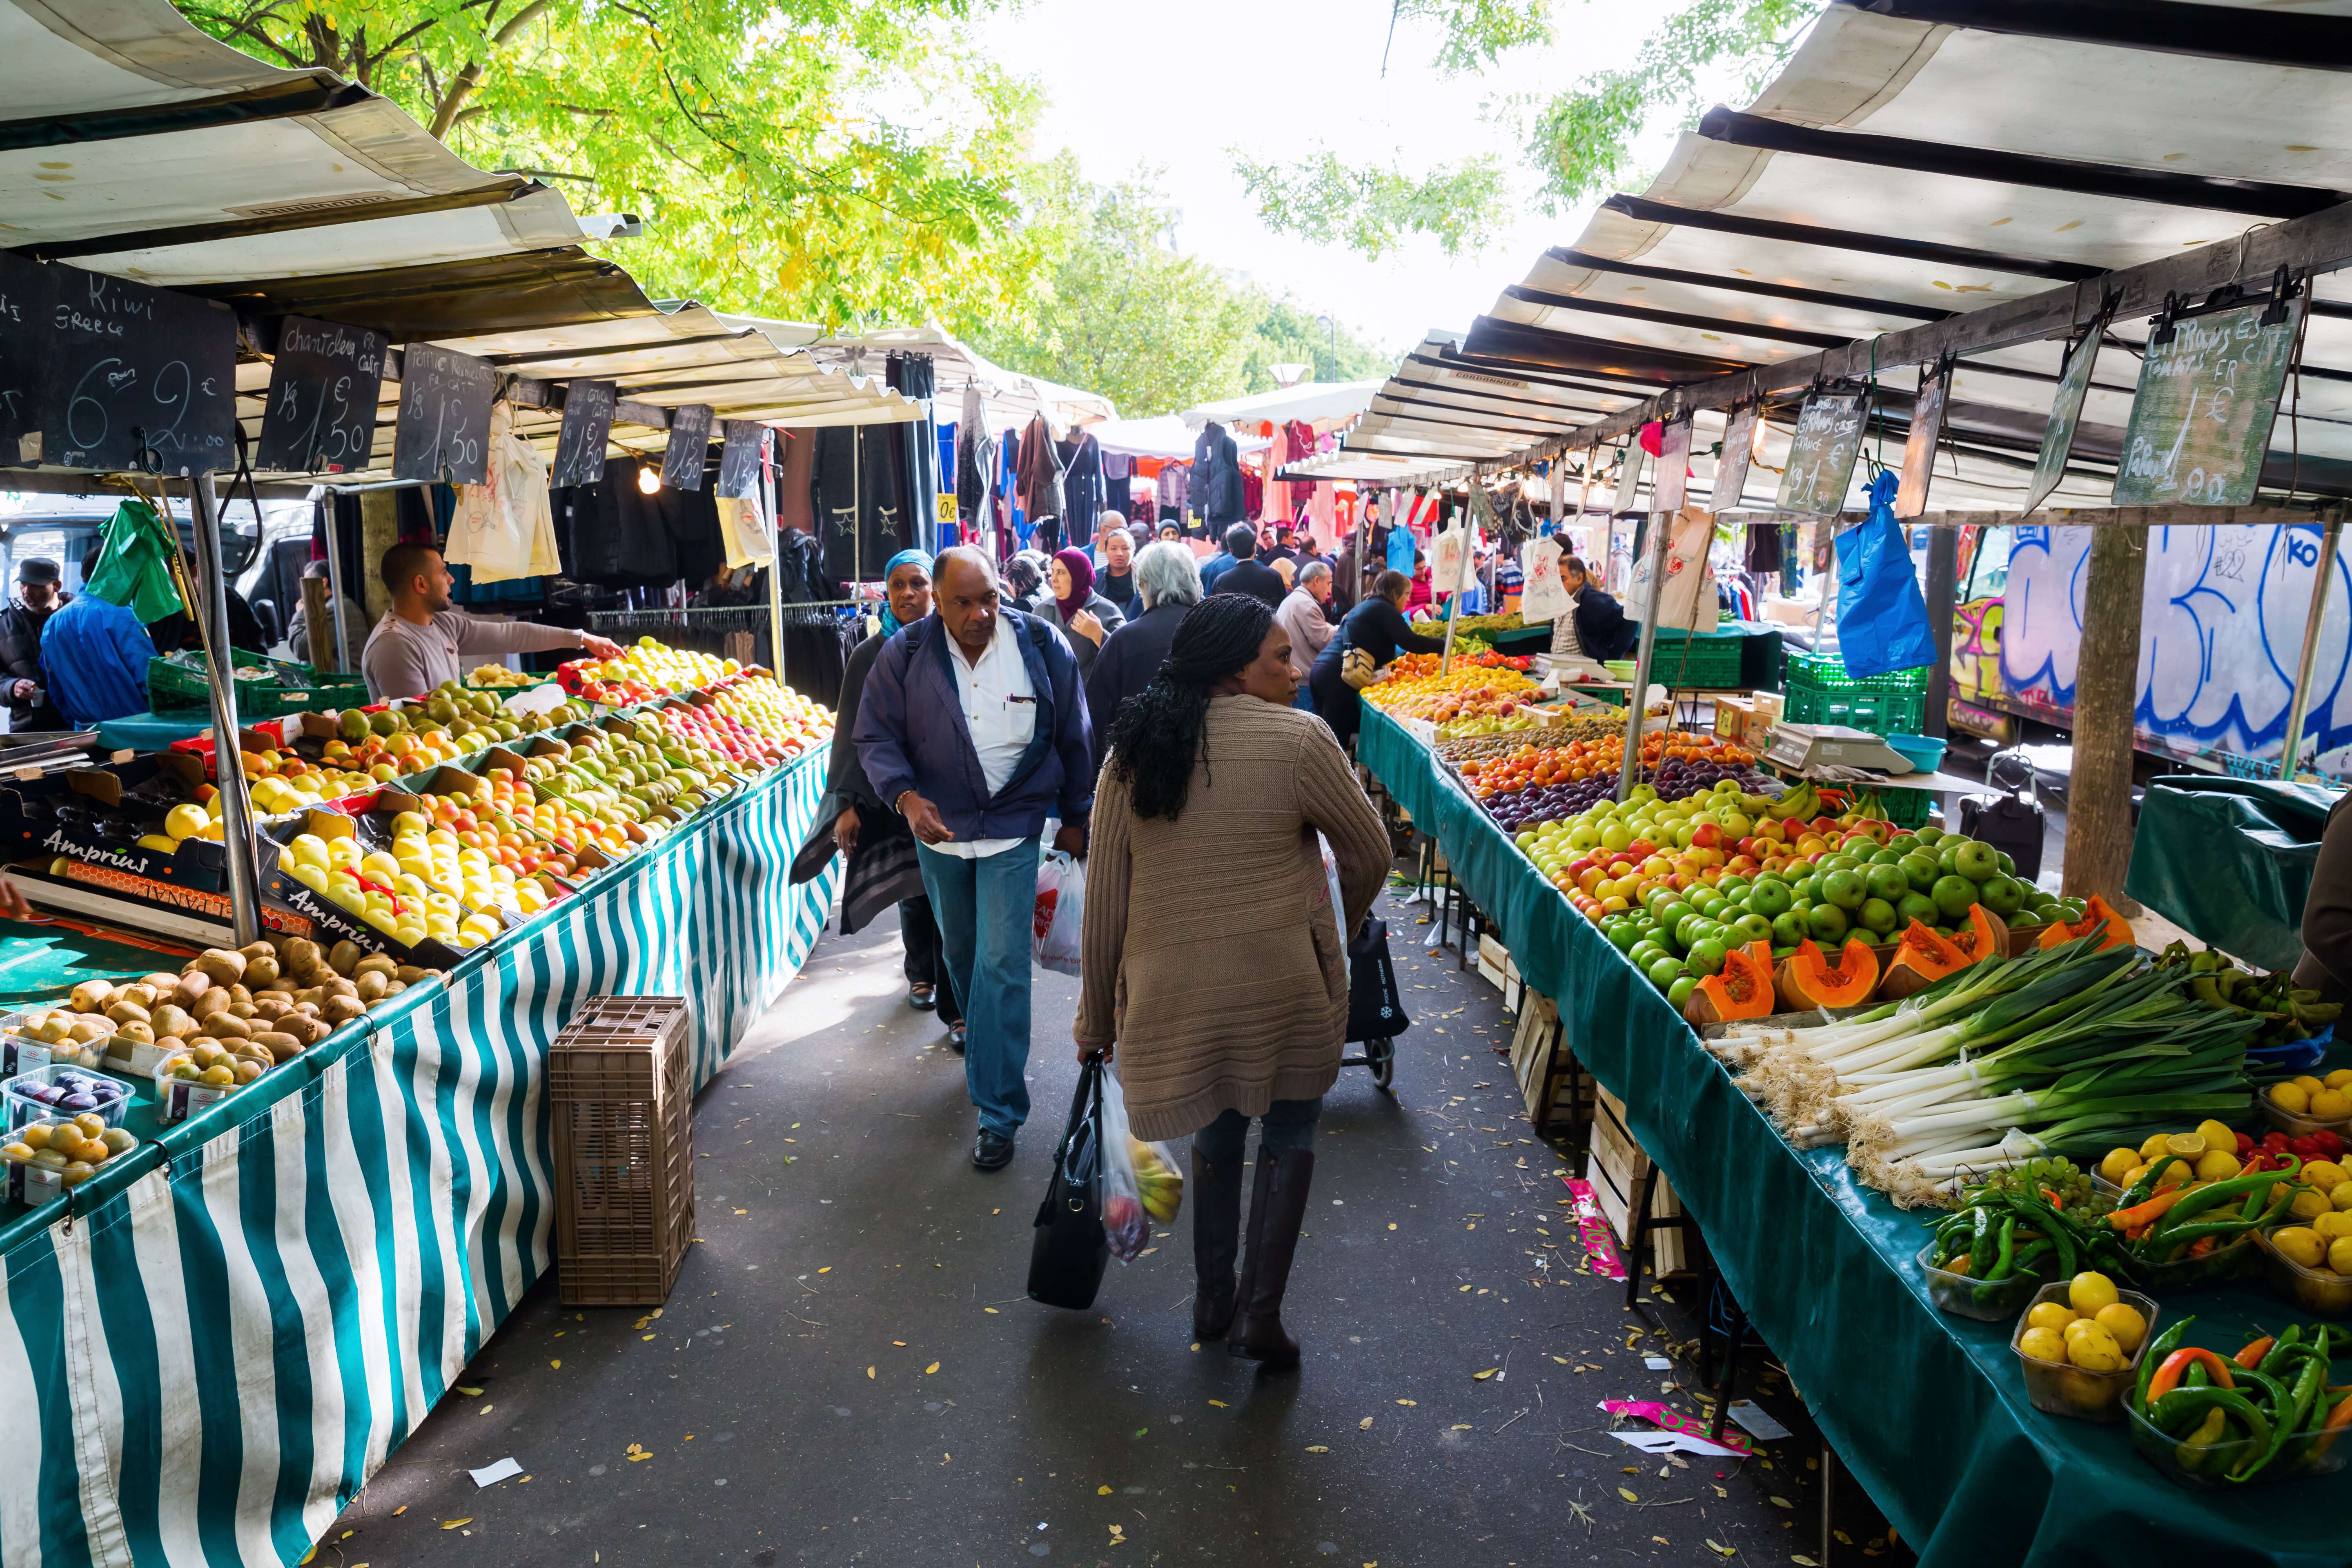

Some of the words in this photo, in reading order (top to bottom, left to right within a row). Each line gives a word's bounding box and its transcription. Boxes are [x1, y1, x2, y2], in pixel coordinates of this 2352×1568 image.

[89, 273, 154, 320] Kiwi
[1456, 372, 1520, 387] CORDONNIER
[2214, 359, 2238, 388] FR
[67, 358, 122, 449] 6
[278, 380, 298, 422] Kg
[408, 382, 423, 421] Kg
[2205, 386, 2234, 423] €
[1794, 434, 1822, 452] FRANCE
[1826, 443, 1844, 471] €
[1787, 464, 1802, 492] Kg
[2288, 535, 2319, 568] KO
[43, 829, 149, 873] Amprius
[288, 889, 386, 954] Amprius
